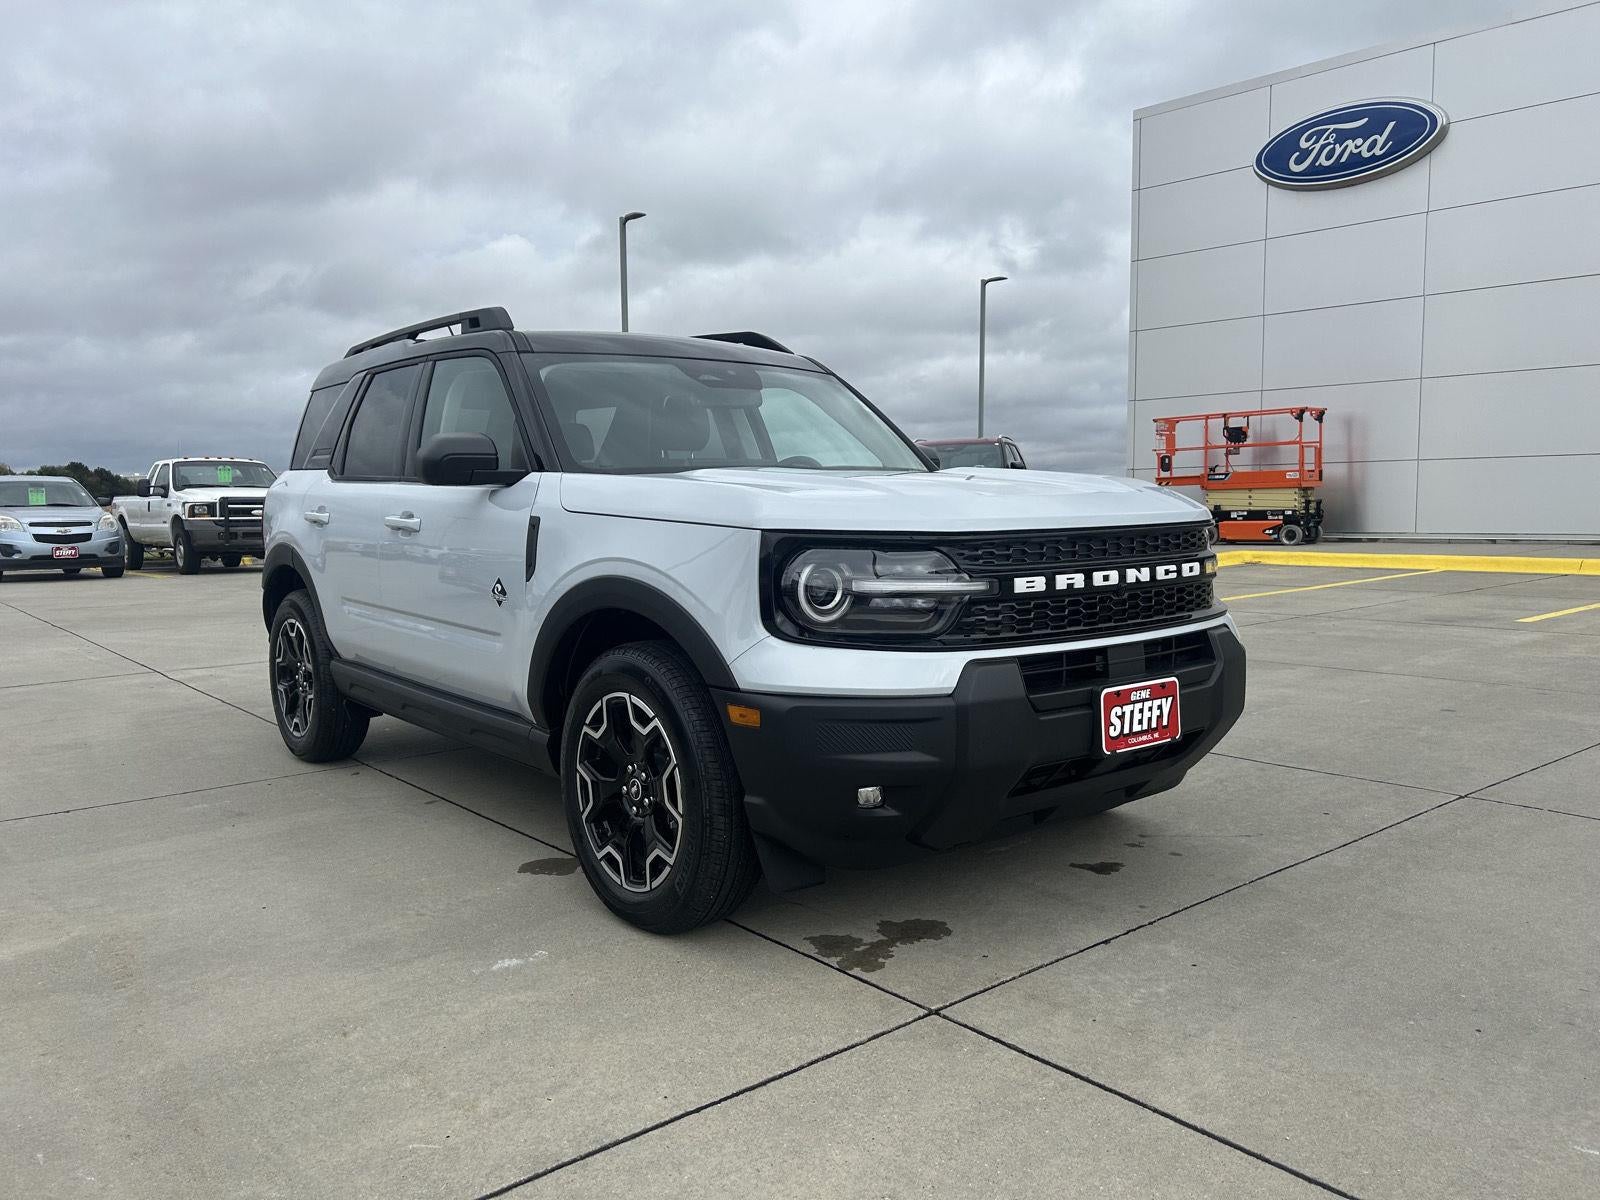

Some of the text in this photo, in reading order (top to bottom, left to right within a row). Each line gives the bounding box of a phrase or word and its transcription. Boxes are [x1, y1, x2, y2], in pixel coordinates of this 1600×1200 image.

[1288, 117, 1396, 173] Ford
[1013, 561, 1201, 594] BRONCO
[1130, 688, 1151, 701] GENE
[1108, 696, 1173, 738] STEFFY
[1127, 733, 1153, 744] COLUMBUS,
